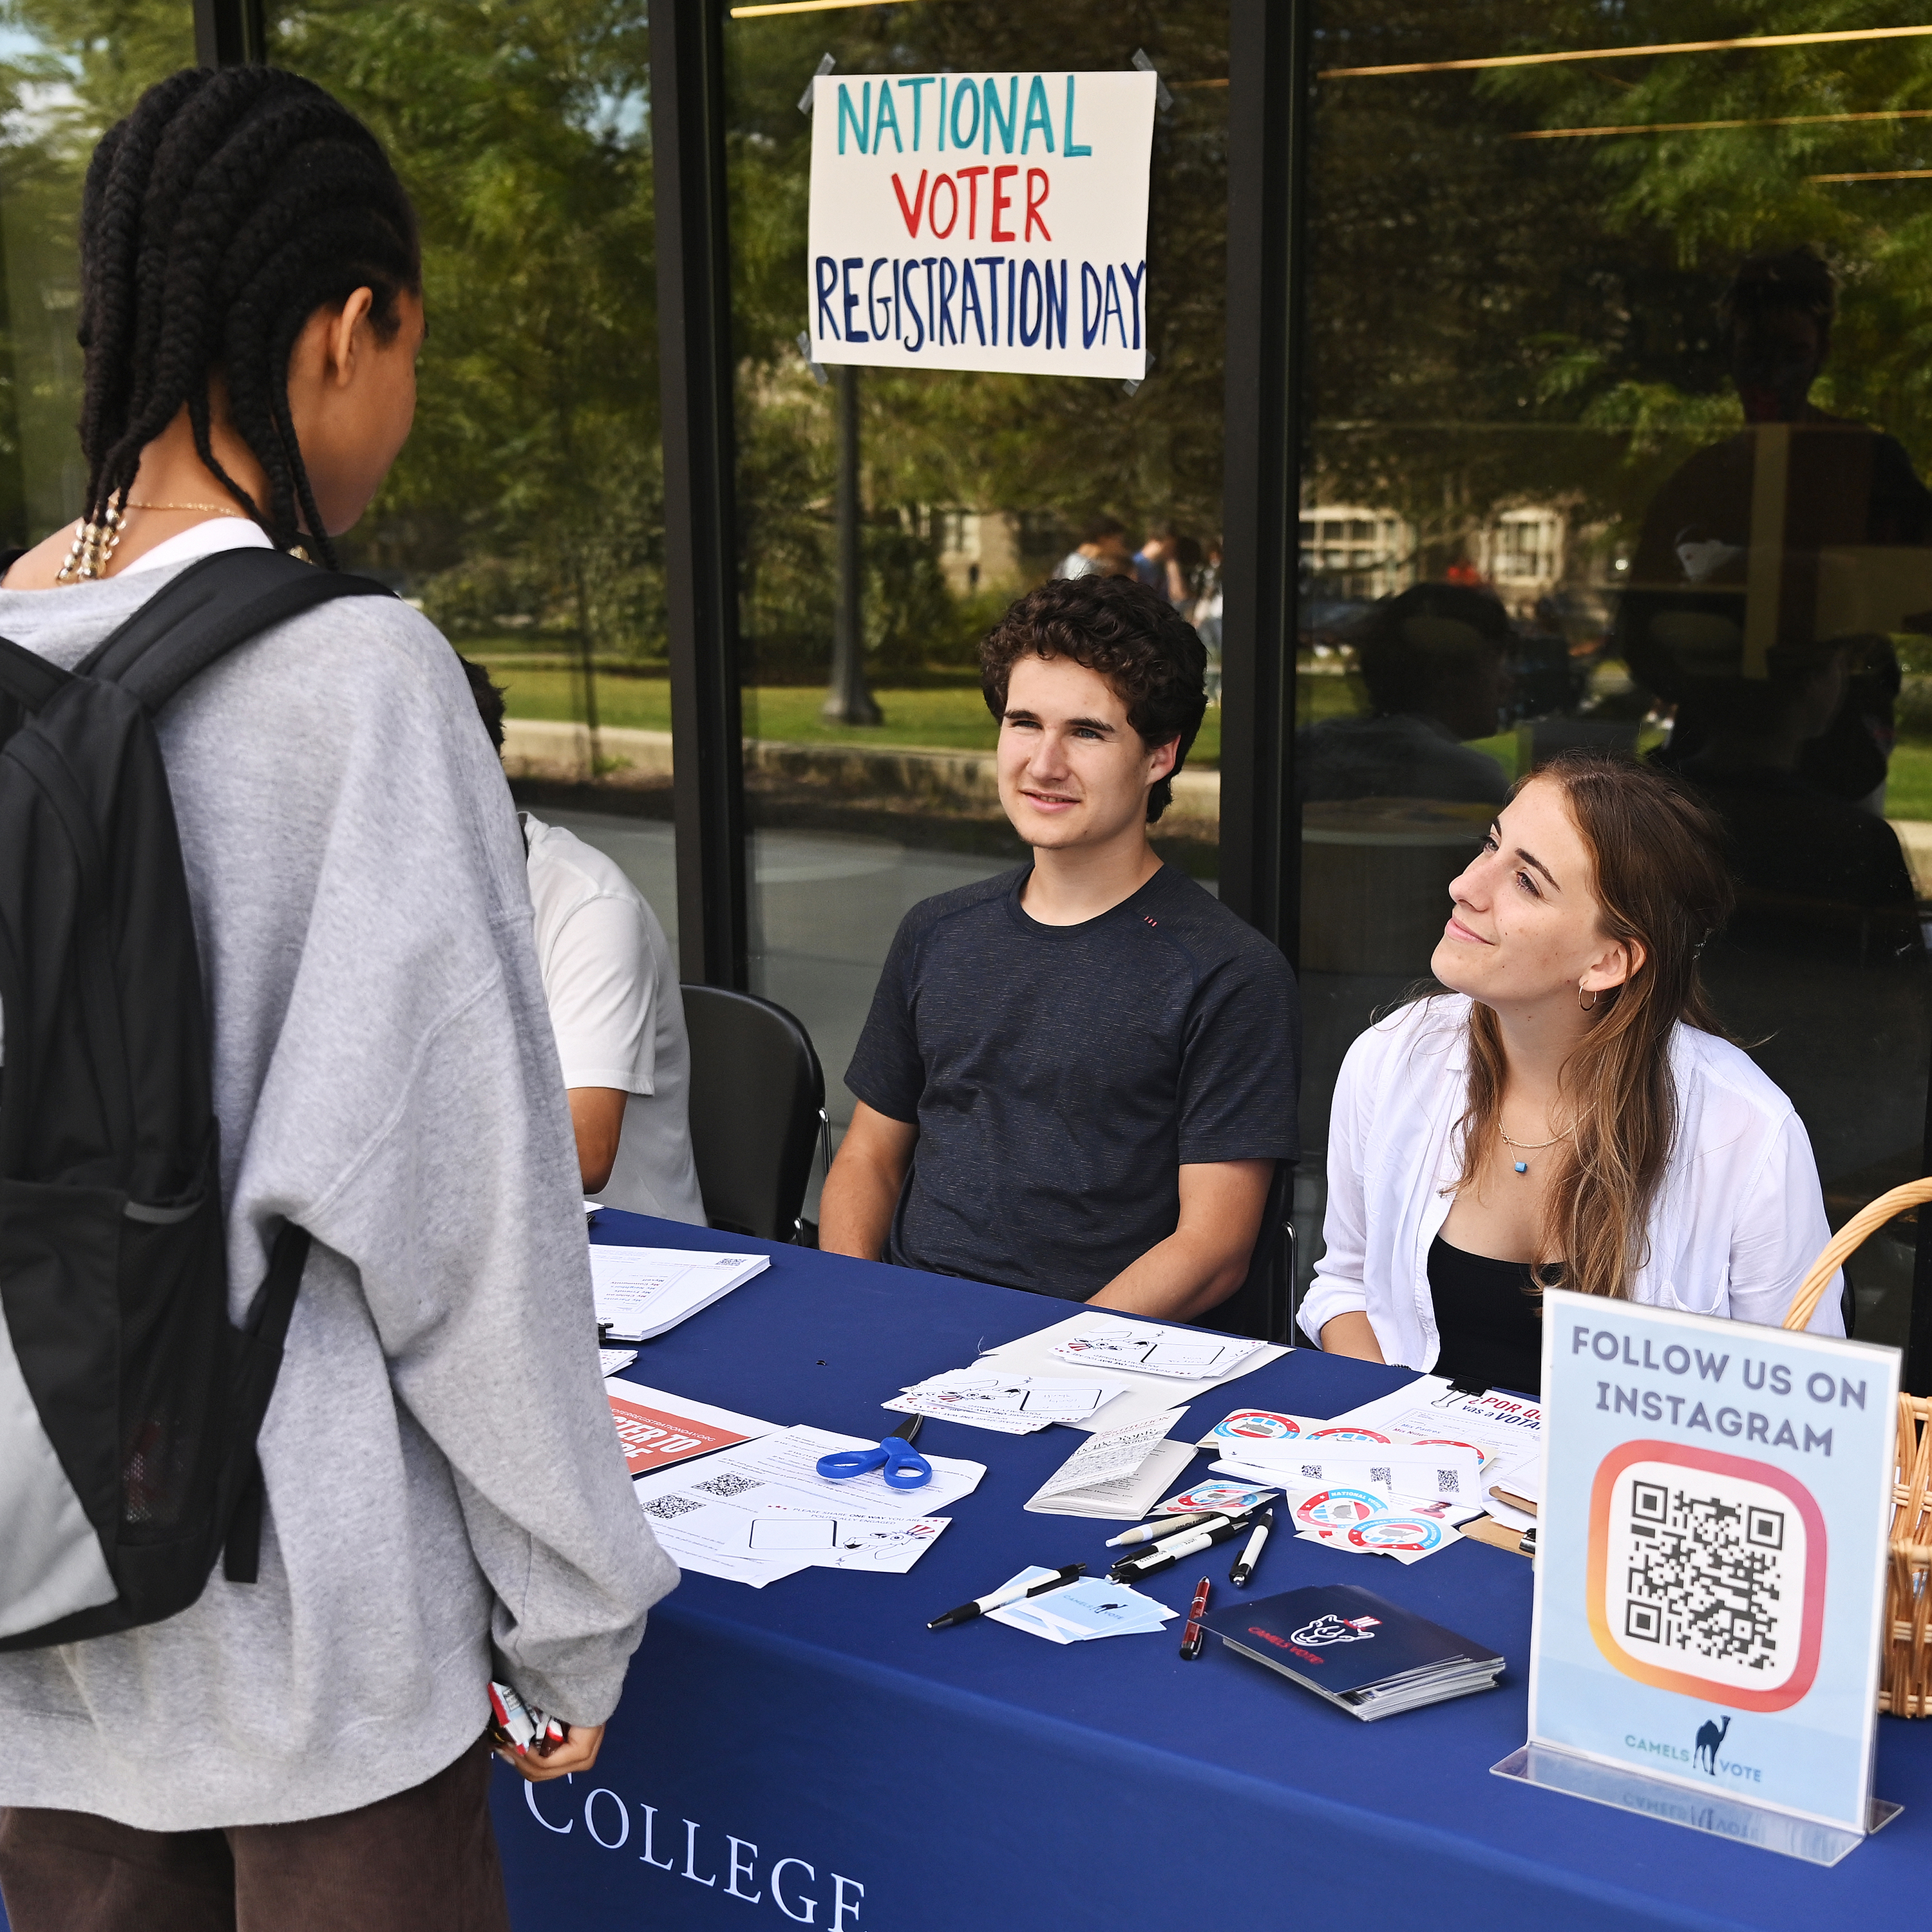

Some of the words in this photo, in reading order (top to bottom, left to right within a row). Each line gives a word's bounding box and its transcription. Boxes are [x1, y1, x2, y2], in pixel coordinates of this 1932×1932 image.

[837, 75, 1092, 158] NATIONAL
[891, 165, 1052, 243] VOTER
[815, 256, 1068, 352] REGISTRATION
[1081, 260, 1146, 350] DAY
[1571, 1326, 1730, 1382] FOLLOW
[1743, 1359, 1792, 1395] US
[1806, 1372, 1867, 1410] ON
[646, 1433, 703, 1454] TO
[1463, 1405, 1484, 1414] vas
[1494, 1412, 1541, 1430] VOTA
[1596, 1381, 1835, 1457] INSTAGRAM
[1331, 1491, 1367, 1500] NATIONAL
[1624, 1734, 1690, 1764] CAMELS
[1718, 1761, 1762, 1783] VOTE
[524, 1772, 866, 1932] COLLEGE
